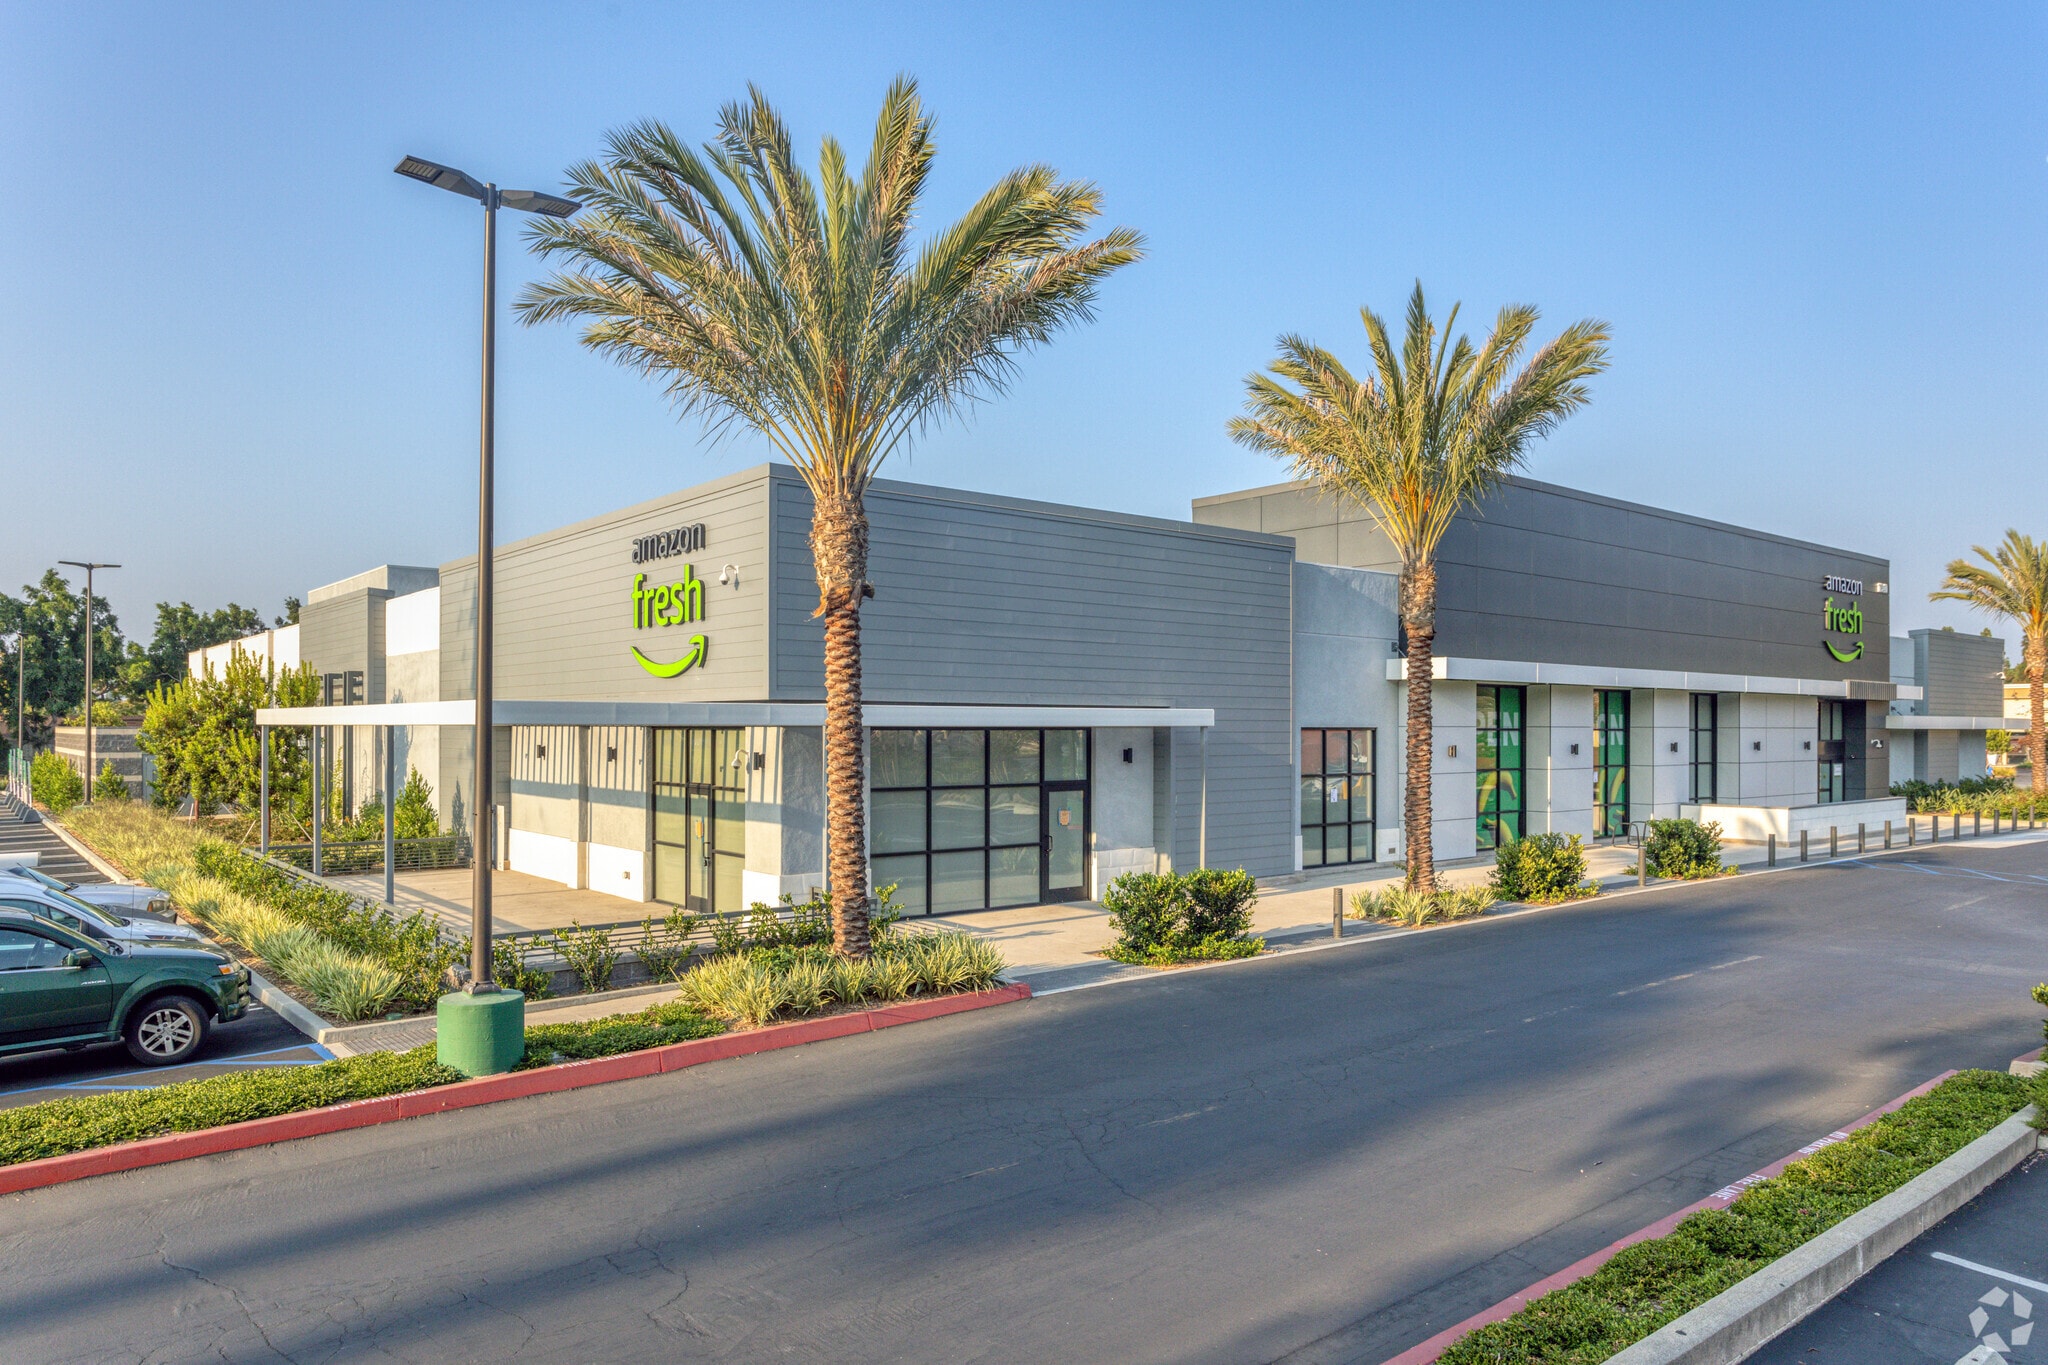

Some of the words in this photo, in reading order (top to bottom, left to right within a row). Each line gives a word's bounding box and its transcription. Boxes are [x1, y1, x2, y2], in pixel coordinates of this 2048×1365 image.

[632, 523, 706, 564] amazon
[631, 563, 705, 630] fresh
[1823, 575, 1863, 596] amazon
[1823, 596, 1863, 634] fresh
[328, 1102, 353, 1112] NO
[360, 1089, 427, 1105] PARKING
[557, 1060, 591, 1069] FIRE
[597, 1053, 633, 1063] LANE
